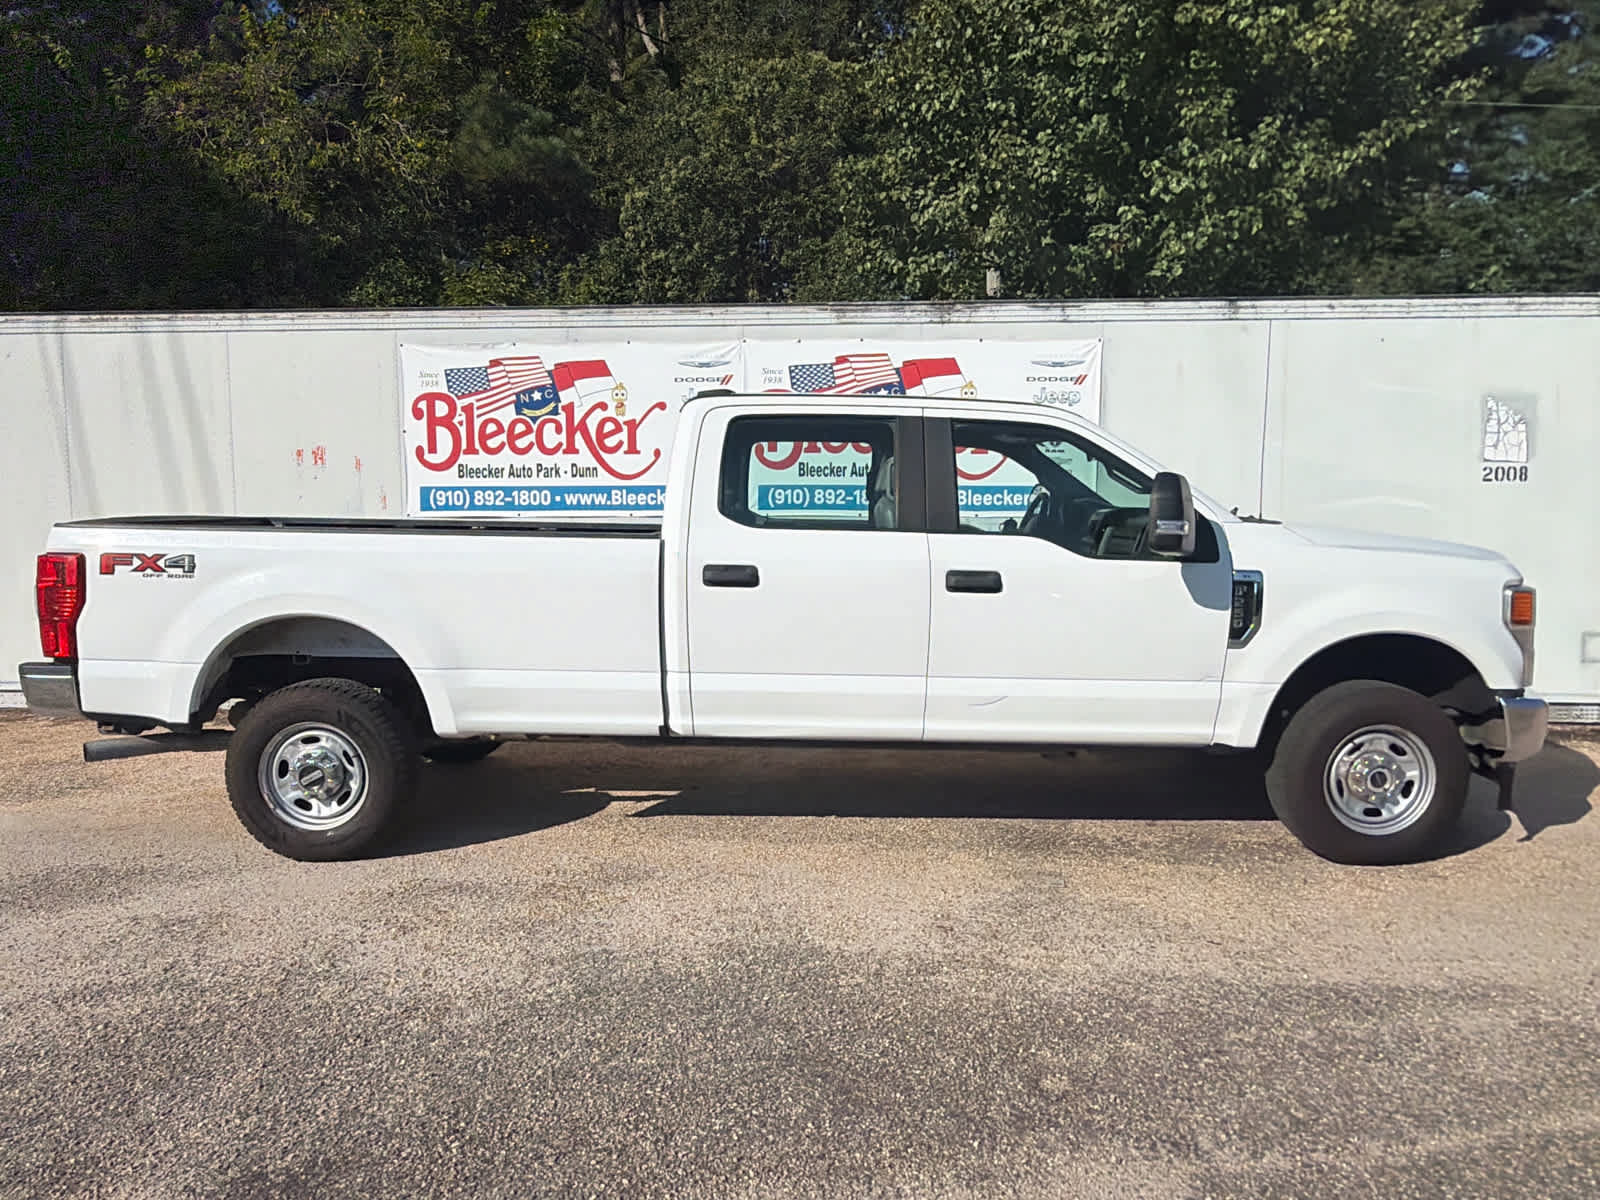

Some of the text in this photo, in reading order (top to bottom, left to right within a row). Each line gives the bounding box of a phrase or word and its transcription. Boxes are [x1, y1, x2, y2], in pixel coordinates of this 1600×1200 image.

[1032, 387, 1081, 406] Jeep
[412, 391, 667, 481] Bleecker
[458, 464, 505, 479] Bleecker
[508, 464, 533, 478] Auto
[536, 463, 561, 478] Park
[571, 463, 598, 478] Dunn
[798, 461, 868, 478] Bleecker Aut
[1482, 466, 1528, 482] 2008
[429, 489, 664, 509] (910) 892-1800 www.Bleeck
[768, 487, 869, 507] (910) 892-18
[958, 490, 1030, 506] Bleecker
[100, 553, 196, 575] FX4
